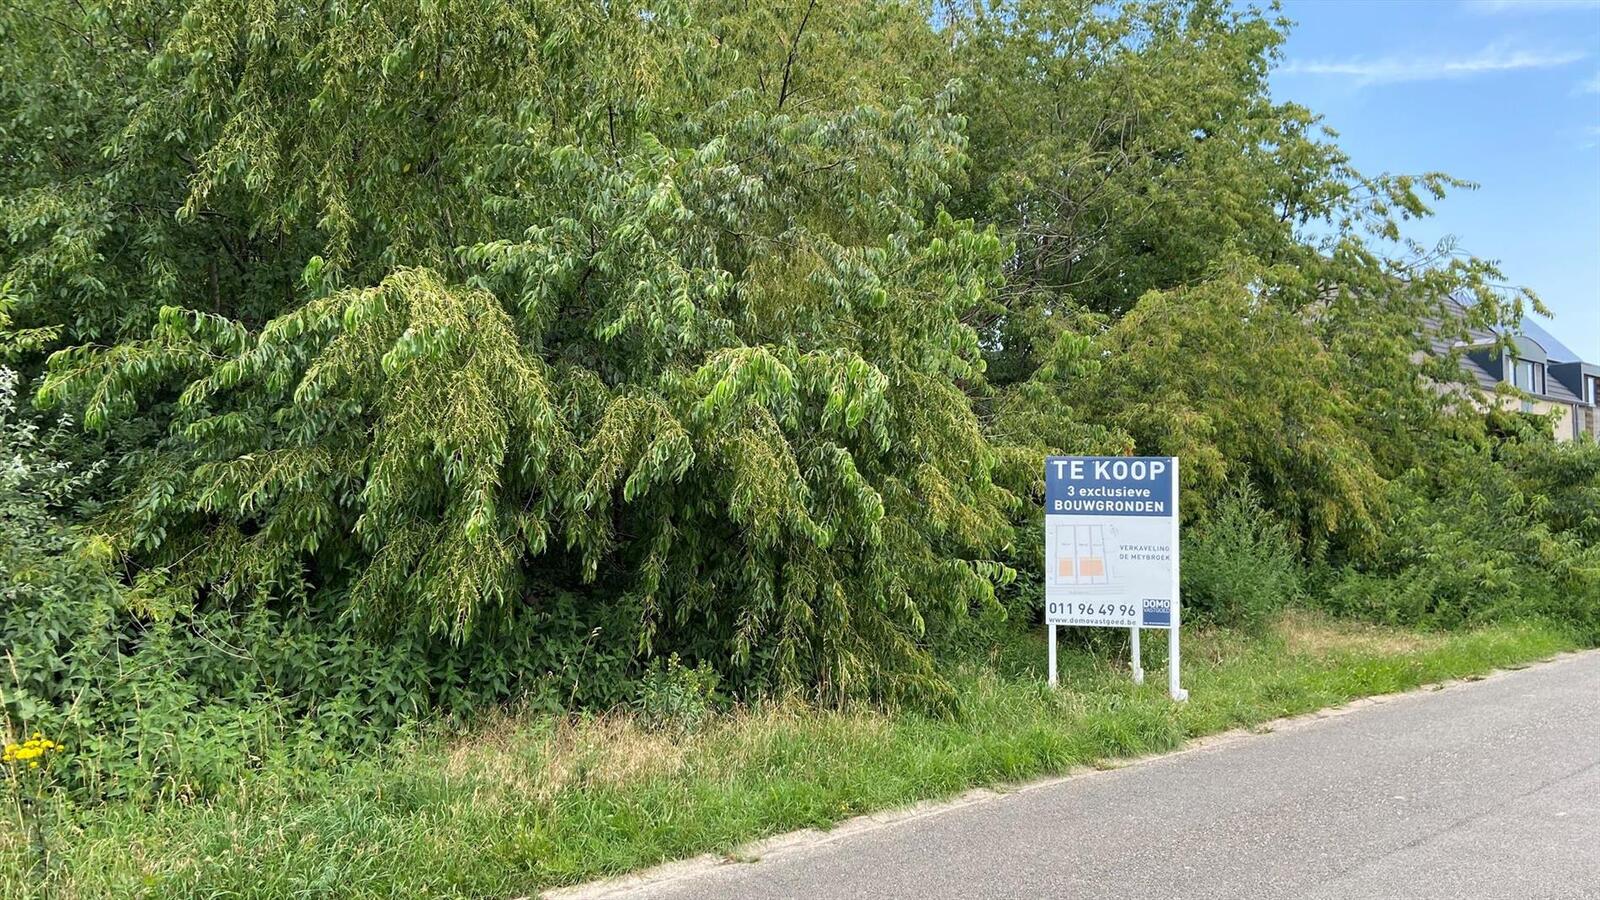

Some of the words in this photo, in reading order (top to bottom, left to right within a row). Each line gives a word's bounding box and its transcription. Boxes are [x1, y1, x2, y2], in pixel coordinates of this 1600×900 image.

[1053, 460, 1084, 480] TE
[1095, 460, 1165, 480] KOOP
[1067, 485, 1075, 497] 3
[1079, 486, 1151, 497] exclusieve
[1054, 500, 1164, 512] BOUWGRONDEN
[1049, 602, 1073, 614] 011
[1078, 603, 1094, 615] 96
[1098, 604, 1115, 616] 49
[1119, 604, 1136, 616] 96
[1143, 599, 1170, 608] DOMO
[1048, 617, 1137, 626] www.domovastgoed.be
